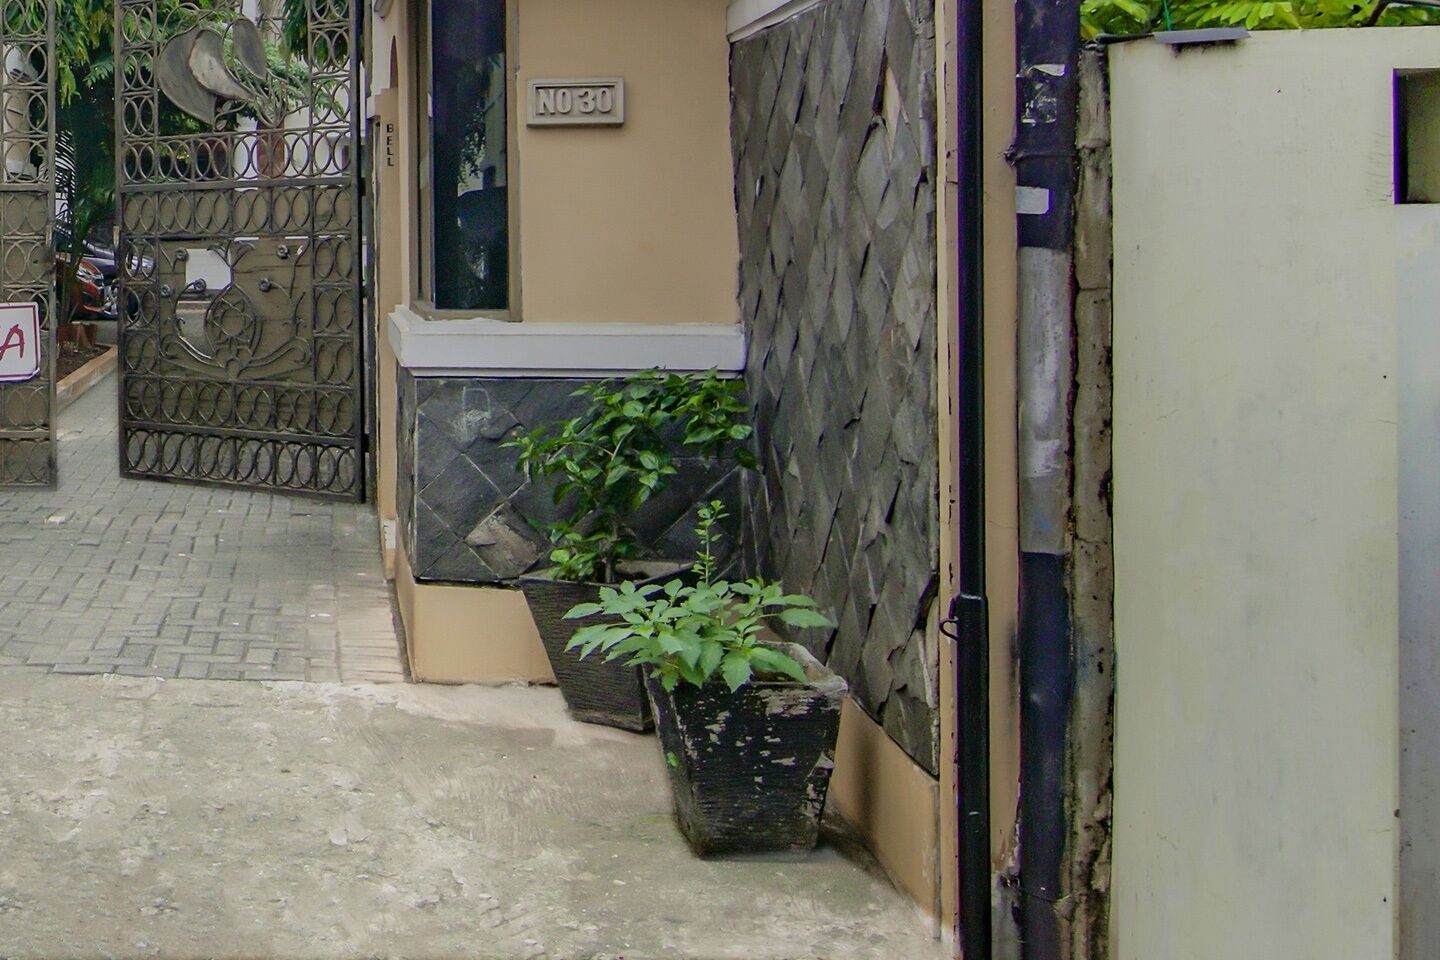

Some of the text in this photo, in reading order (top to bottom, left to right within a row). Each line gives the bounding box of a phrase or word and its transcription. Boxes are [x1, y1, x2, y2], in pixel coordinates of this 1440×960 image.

[537, 87, 613, 116] NO 30
[386, 124, 394, 167] BELL
